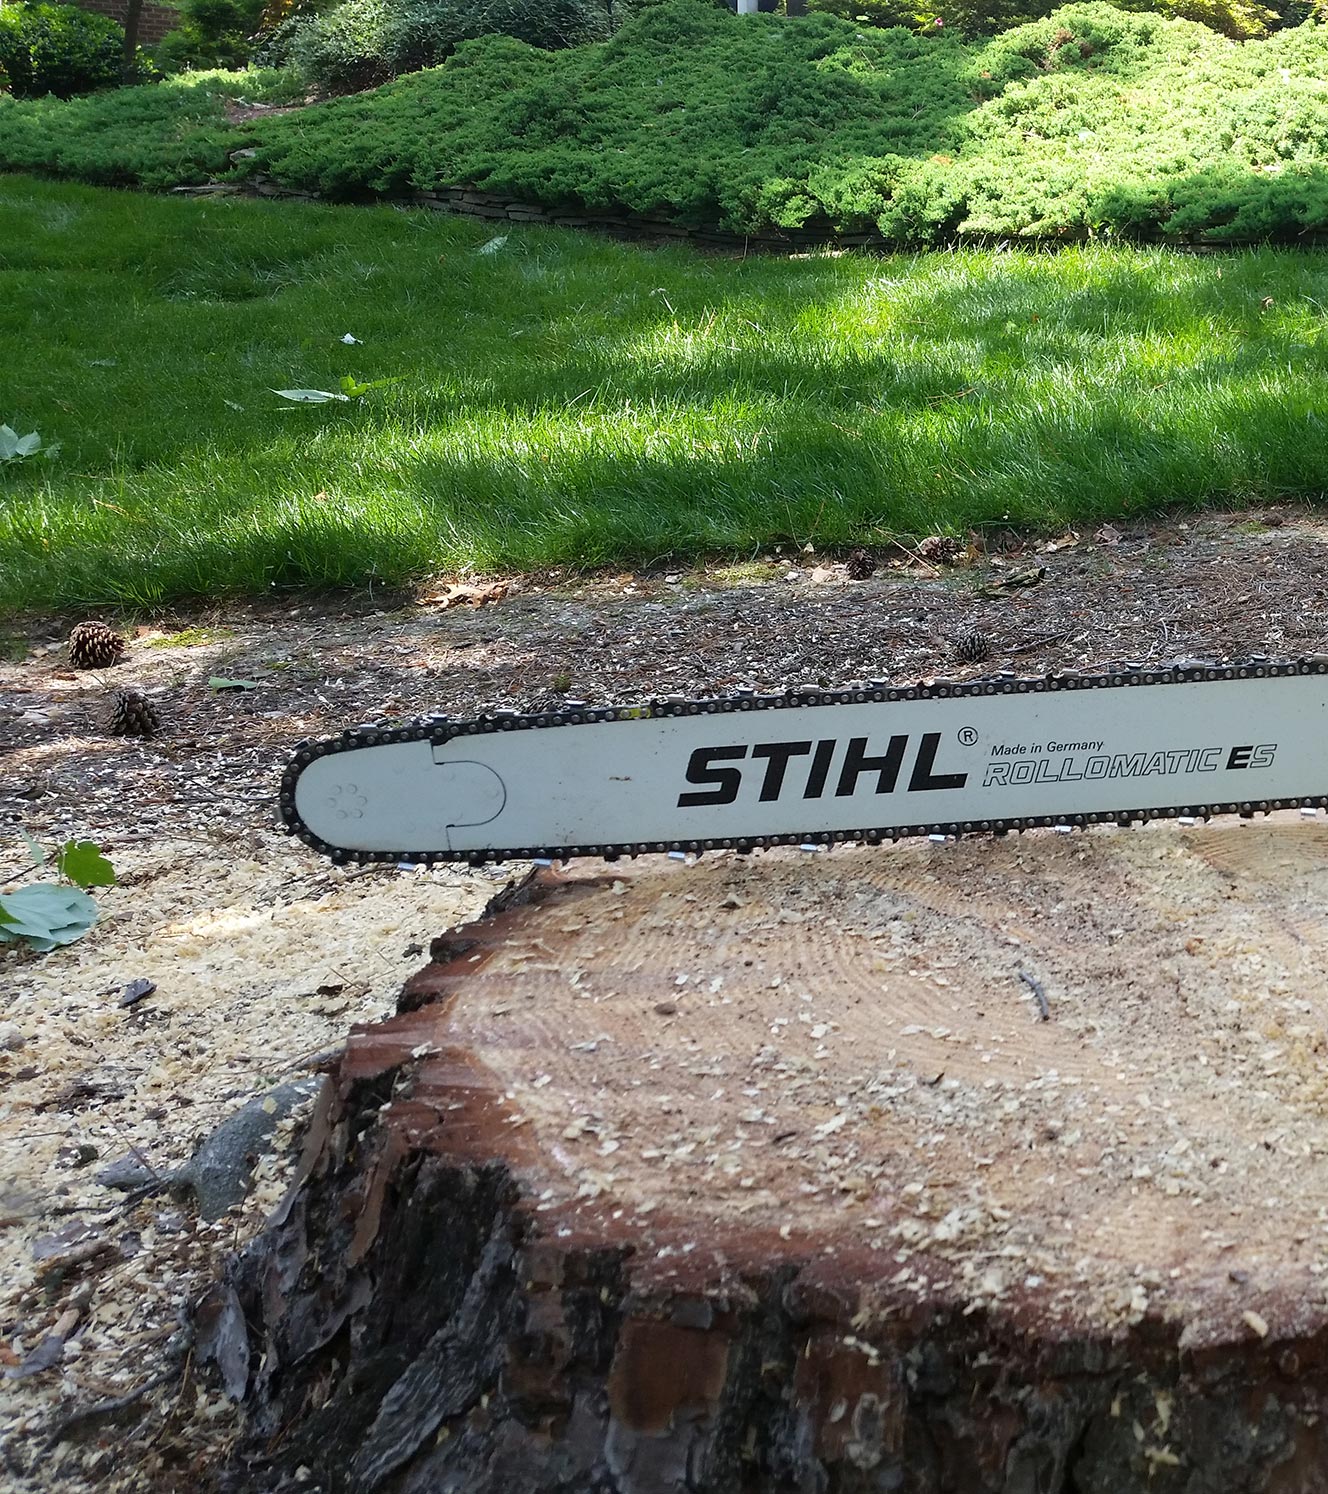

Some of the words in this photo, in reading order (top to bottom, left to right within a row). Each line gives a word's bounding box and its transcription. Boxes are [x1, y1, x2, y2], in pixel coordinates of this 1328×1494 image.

[676, 732, 969, 808] STIHL
[982, 748, 1223, 788] ROLLOMATIC
[1225, 744, 1278, 770] ES
[991, 744, 1027, 756] Made
[1030, 742, 1042, 754] in
[1047, 740, 1105, 752] Germany
